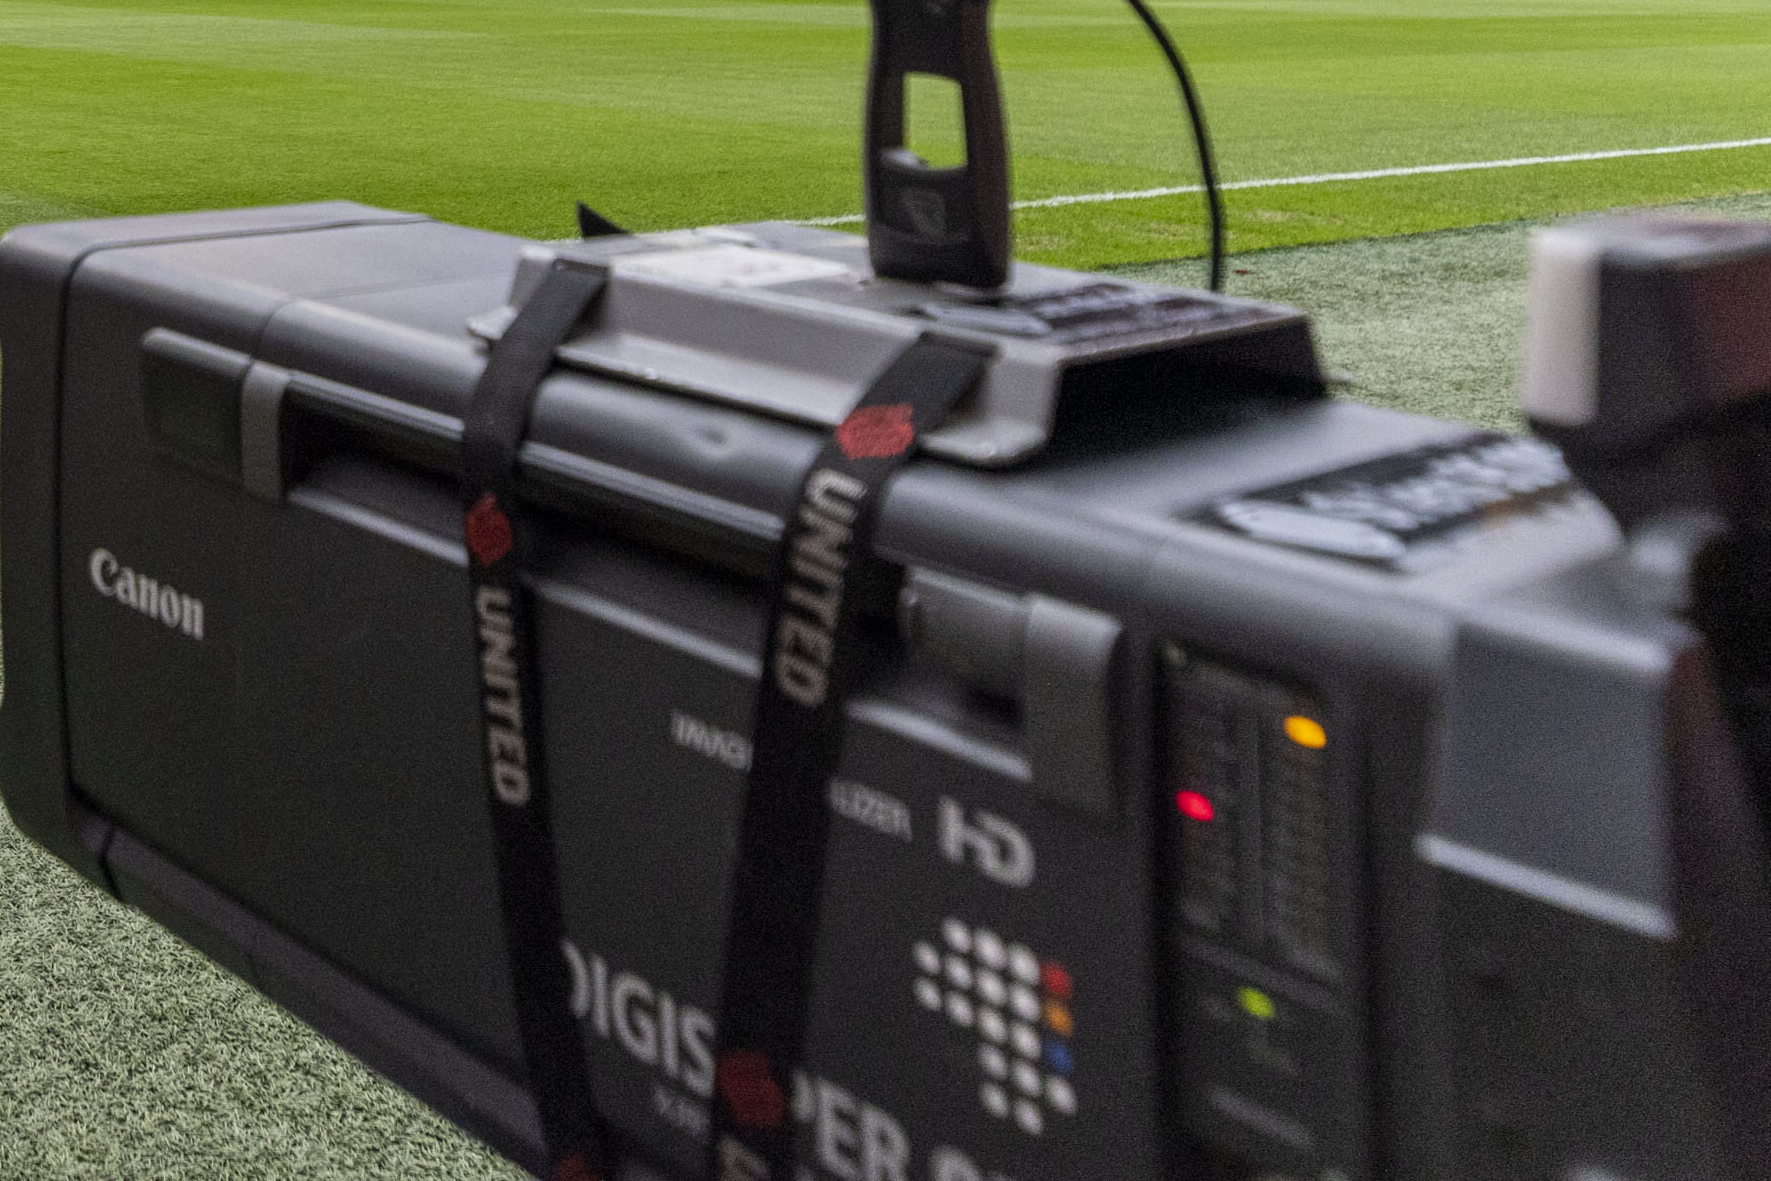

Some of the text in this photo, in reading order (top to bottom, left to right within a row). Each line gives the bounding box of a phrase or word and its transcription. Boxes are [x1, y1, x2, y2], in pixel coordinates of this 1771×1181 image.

[91, 547, 204, 641] Canon
[476, 586, 531, 805] UNITED
[776, 469, 868, 706] UNITED
